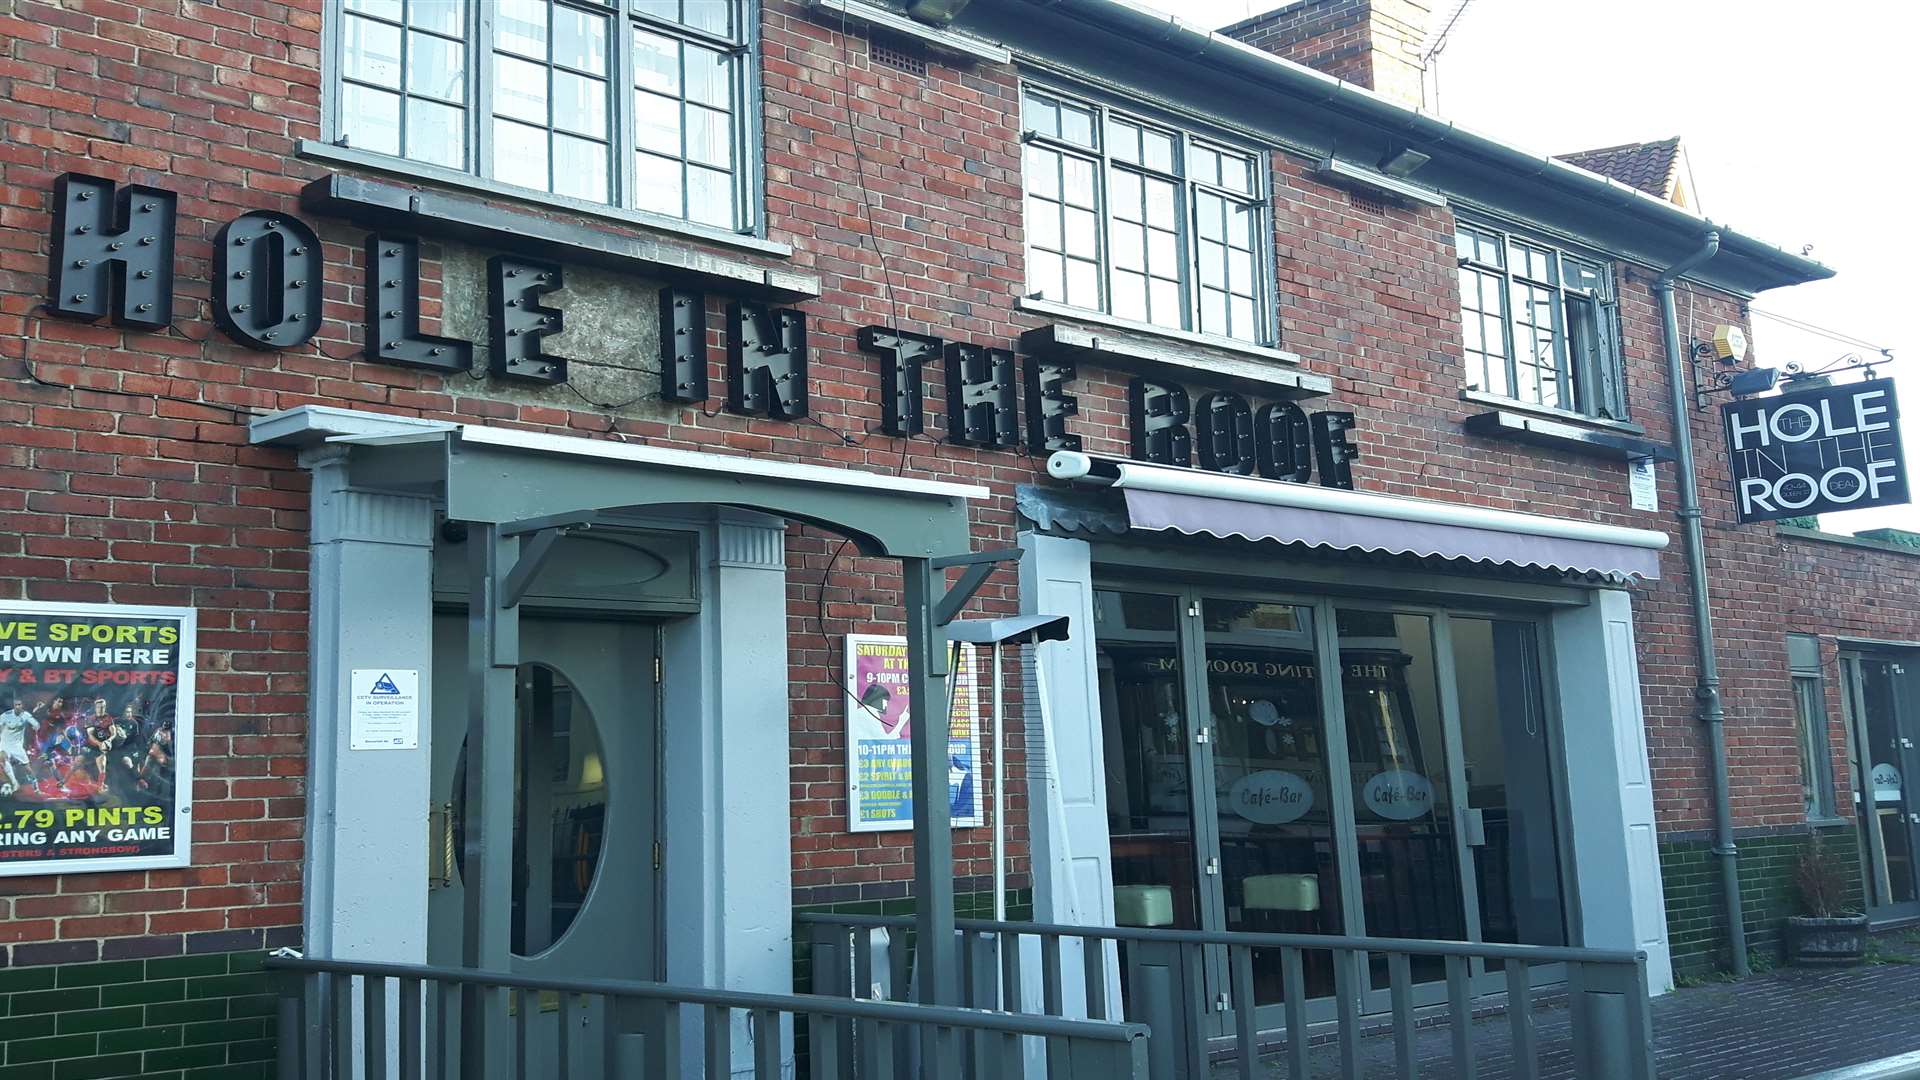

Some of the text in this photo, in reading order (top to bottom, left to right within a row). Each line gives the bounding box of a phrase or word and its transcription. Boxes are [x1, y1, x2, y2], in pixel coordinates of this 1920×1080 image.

[47, 172, 1359, 490] HOLE IN THE ROOF
[1731, 390, 1890, 450] HOLE
[1779, 415, 1810, 430] THE
[1735, 429, 1896, 480] IN THE
[1740, 461, 1896, 515] ROOF
[49, 623, 178, 644] SPORTS
[93, 648, 169, 664] HERE
[884, 658, 894, 669] AT
[19, 668, 37, 684] &
[44, 669, 77, 684] BT
[82, 670, 176, 685] SPORTS
[866, 673, 899, 683] 9-10PM
[1241, 786, 1303, 805] Café-Bar
[1373, 785, 1427, 804] Café-Bar
[0, 806, 163, 829] .79 PINTS
[0, 827, 170, 846] ING ANY GAME
